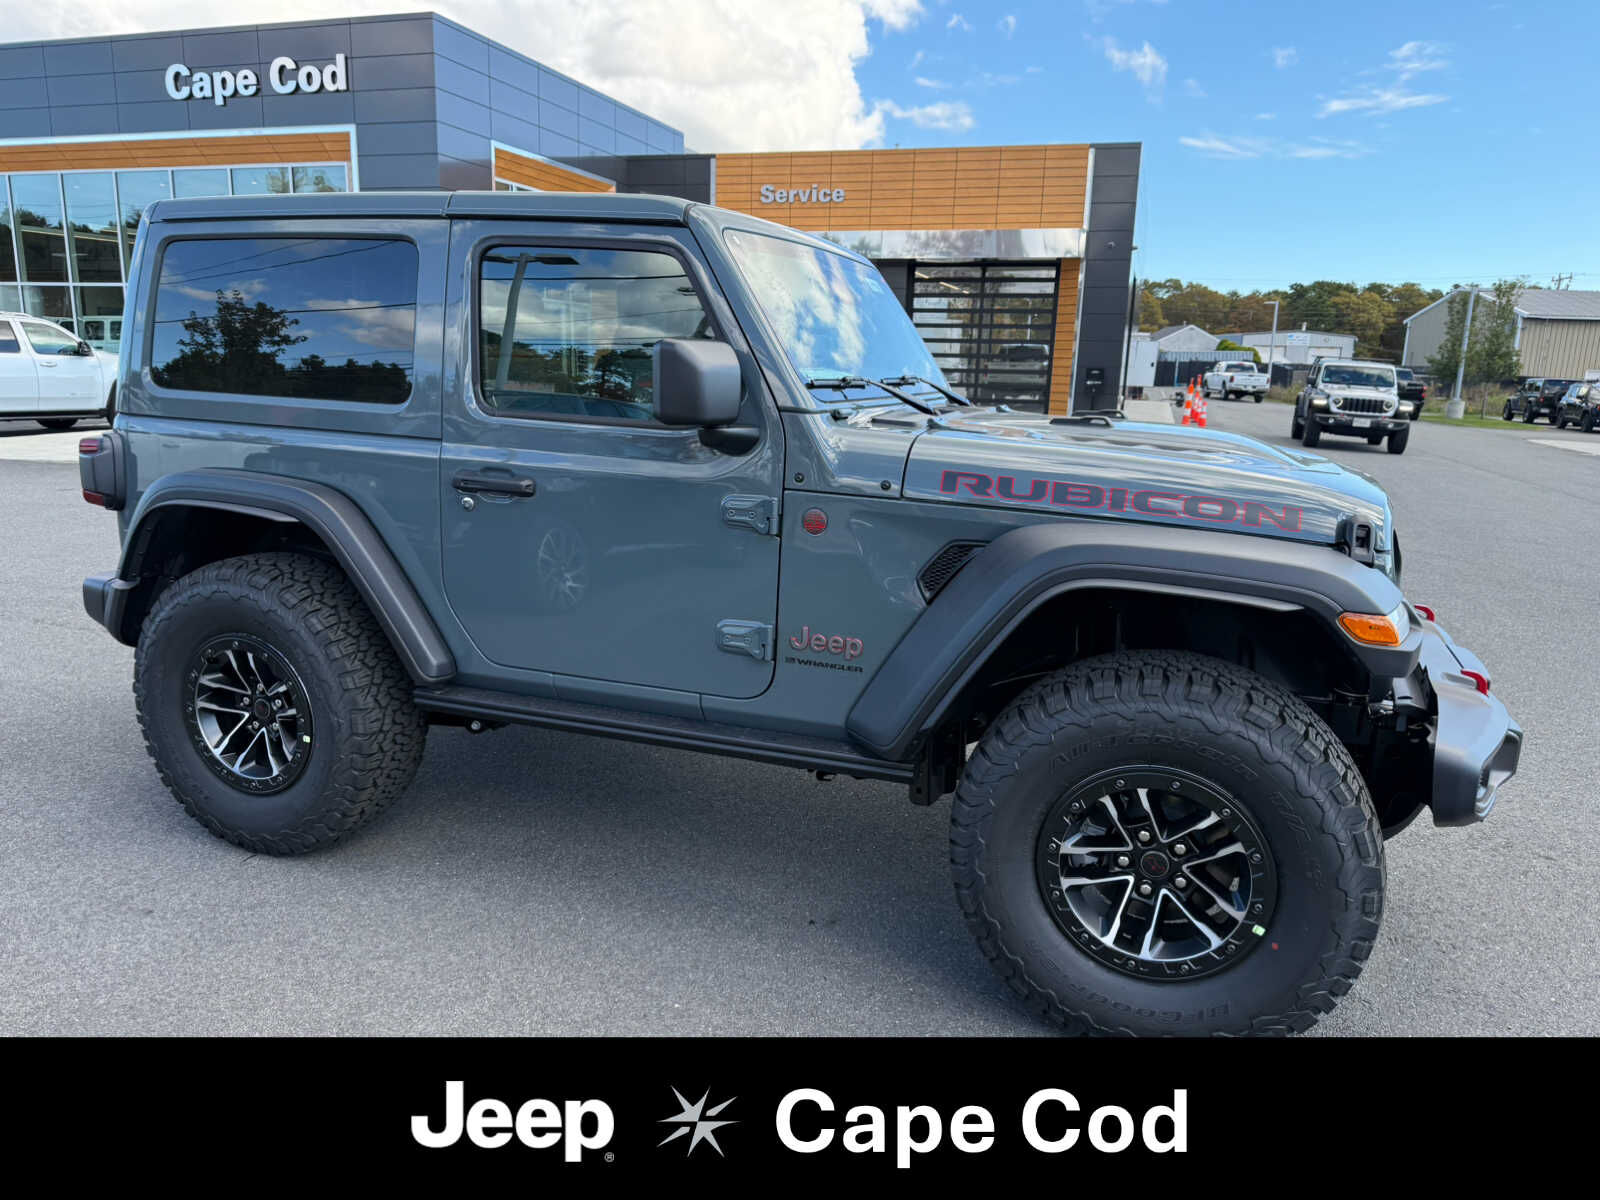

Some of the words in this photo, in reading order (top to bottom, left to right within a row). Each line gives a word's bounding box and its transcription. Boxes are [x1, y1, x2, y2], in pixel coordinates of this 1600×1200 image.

[165, 63, 259, 106] Cape
[269, 53, 348, 94] Cod
[760, 184, 846, 204] Service
[940, 470, 1303, 533] RUBICON
[789, 625, 864, 661] Jeep
[797, 657, 864, 673] WRANGLER
